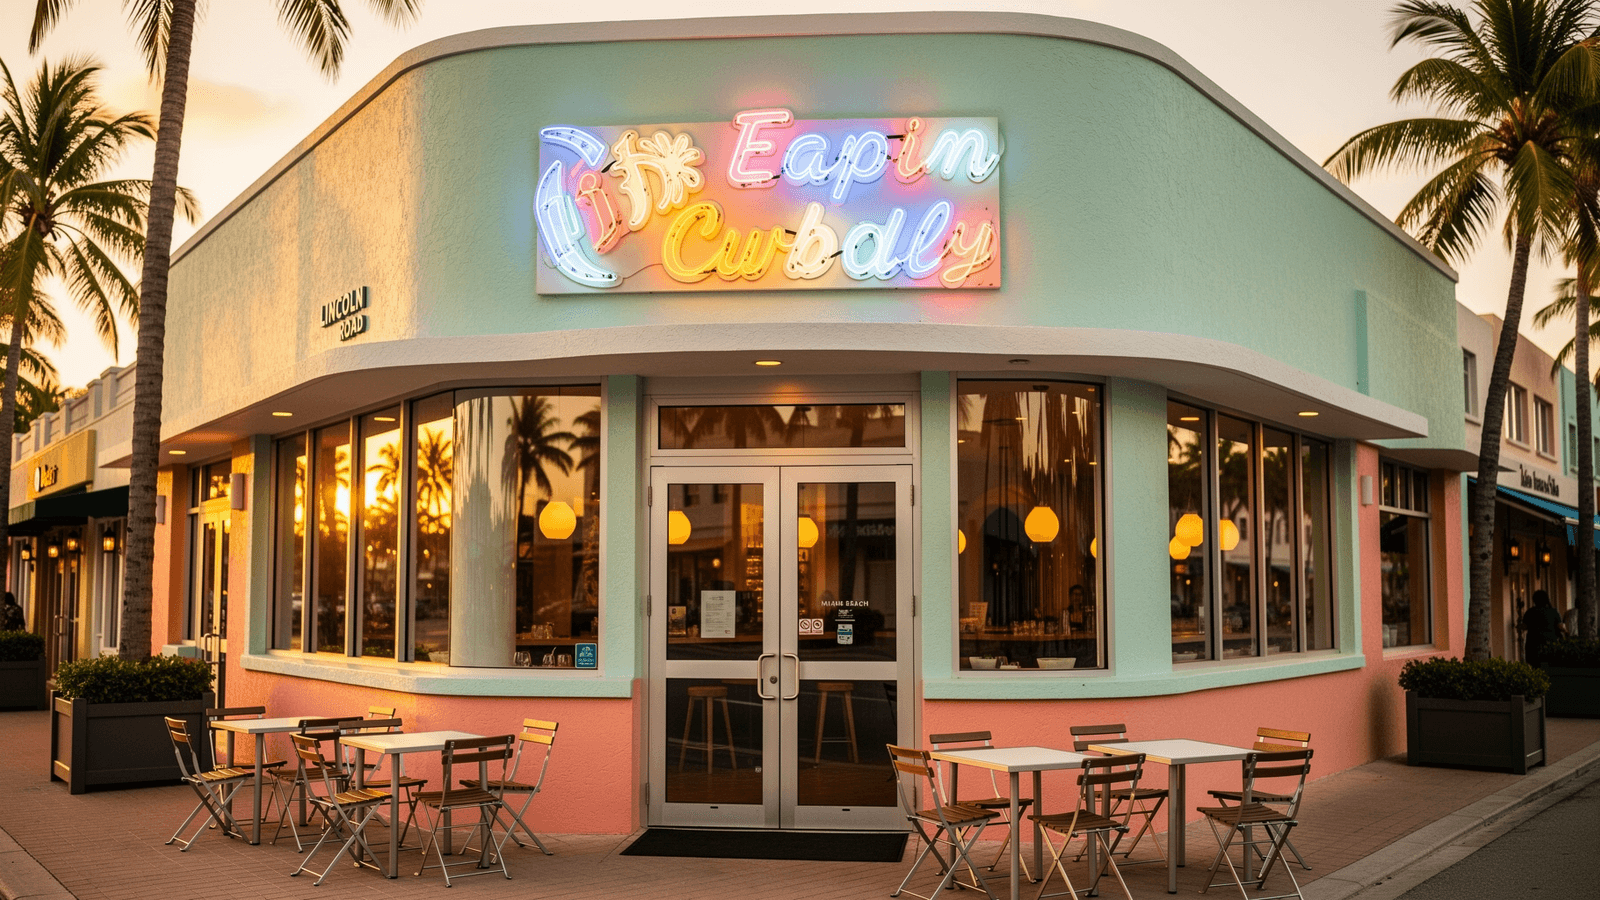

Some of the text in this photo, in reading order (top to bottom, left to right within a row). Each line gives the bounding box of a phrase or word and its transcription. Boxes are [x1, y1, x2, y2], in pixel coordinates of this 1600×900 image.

[727, 108, 1002, 205] Eapin
[321, 286, 367, 328] LINCOLN
[340, 314, 366, 341] ROAD
